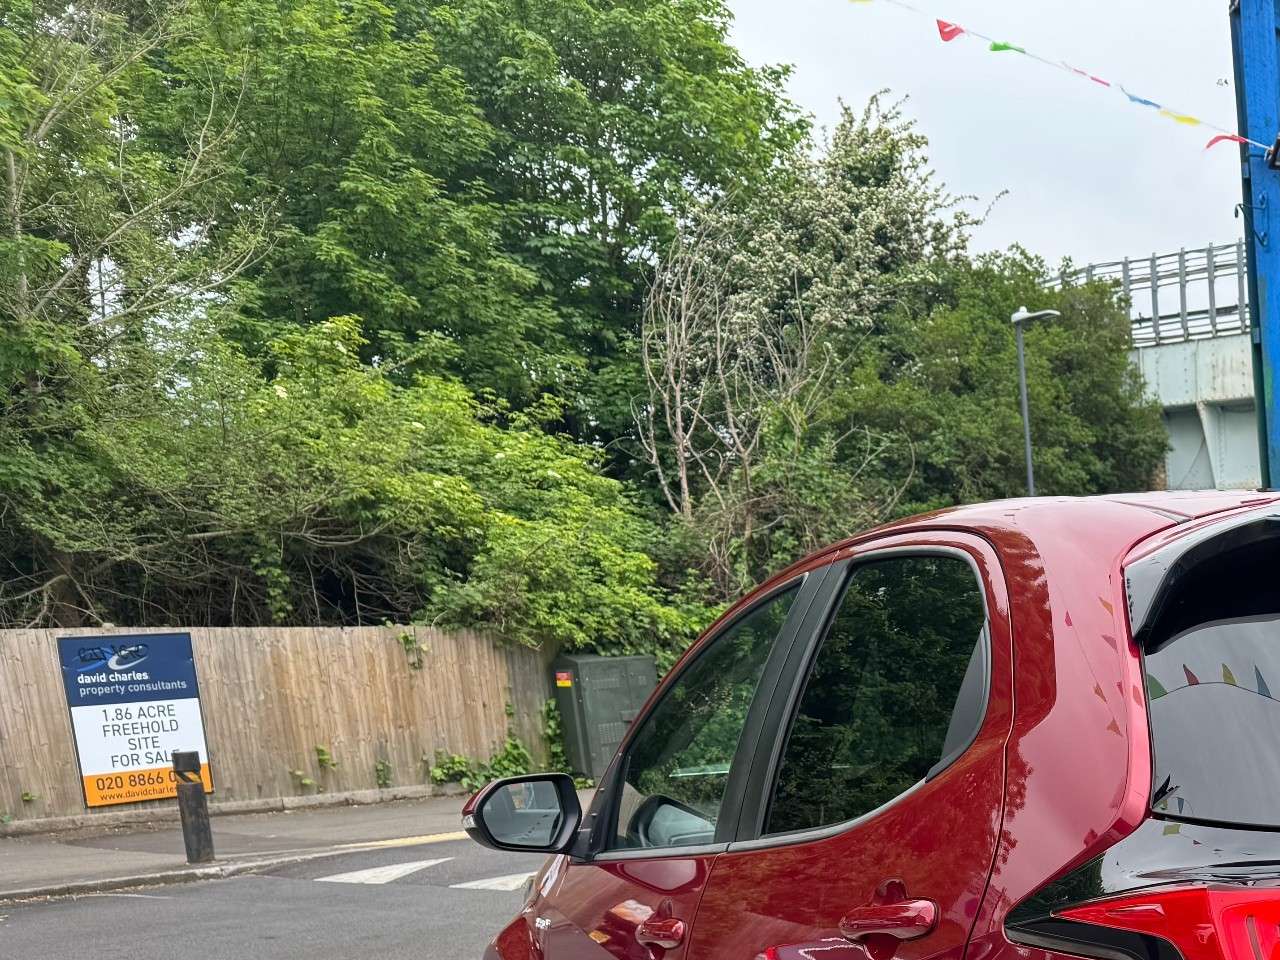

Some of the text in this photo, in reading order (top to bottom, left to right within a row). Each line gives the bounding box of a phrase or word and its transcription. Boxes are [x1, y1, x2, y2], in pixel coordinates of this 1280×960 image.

[77, 670, 149, 684] david charles
[79, 679, 188, 698] property consultants
[102, 704, 176, 722] 1.86 ACRE
[103, 719, 180, 738] FREEHOLD
[128, 736, 161, 751] SITE
[111, 754, 141, 768] FOR
[96, 776, 124, 791] 020
[128, 772, 164, 787] 8866
